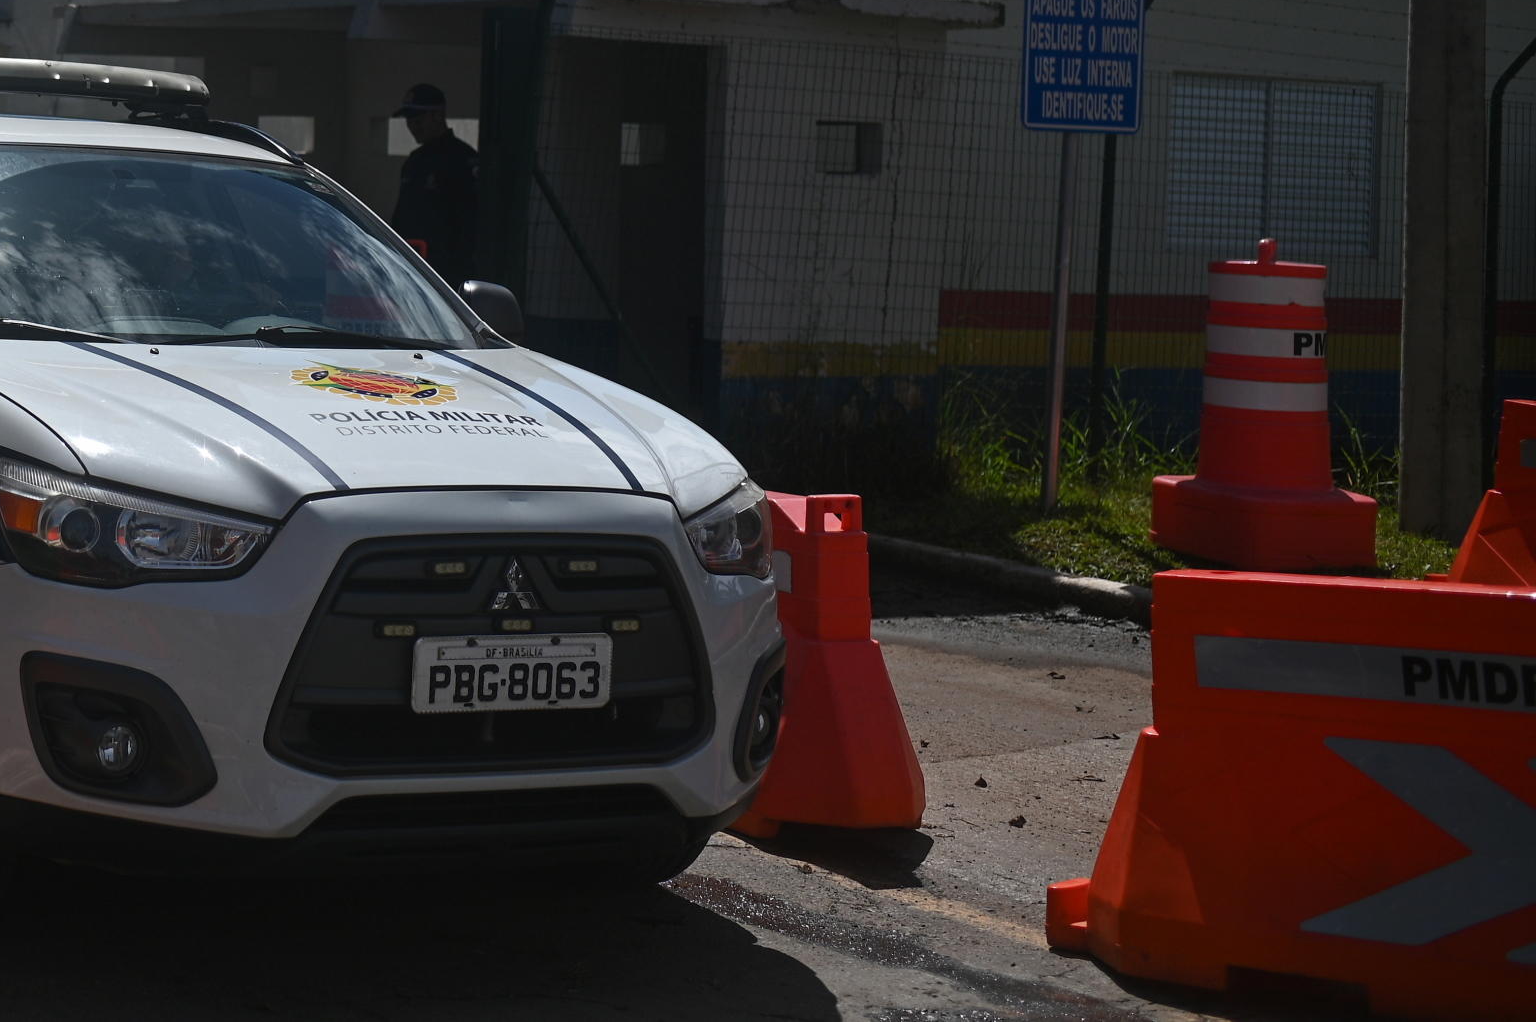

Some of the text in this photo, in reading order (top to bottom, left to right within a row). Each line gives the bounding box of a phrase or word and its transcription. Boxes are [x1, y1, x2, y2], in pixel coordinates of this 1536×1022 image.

[1029, 22, 1138, 55] DESLIGUE O MOTOR
[1034, 56, 1133, 88] USE LUZ INTERNA
[1042, 90, 1125, 122] IDENTIFIQUE-SE
[310, 409, 544, 427] POLÍCIA MILITAR
[336, 424, 549, 439] DISTRITO FEDERAL
